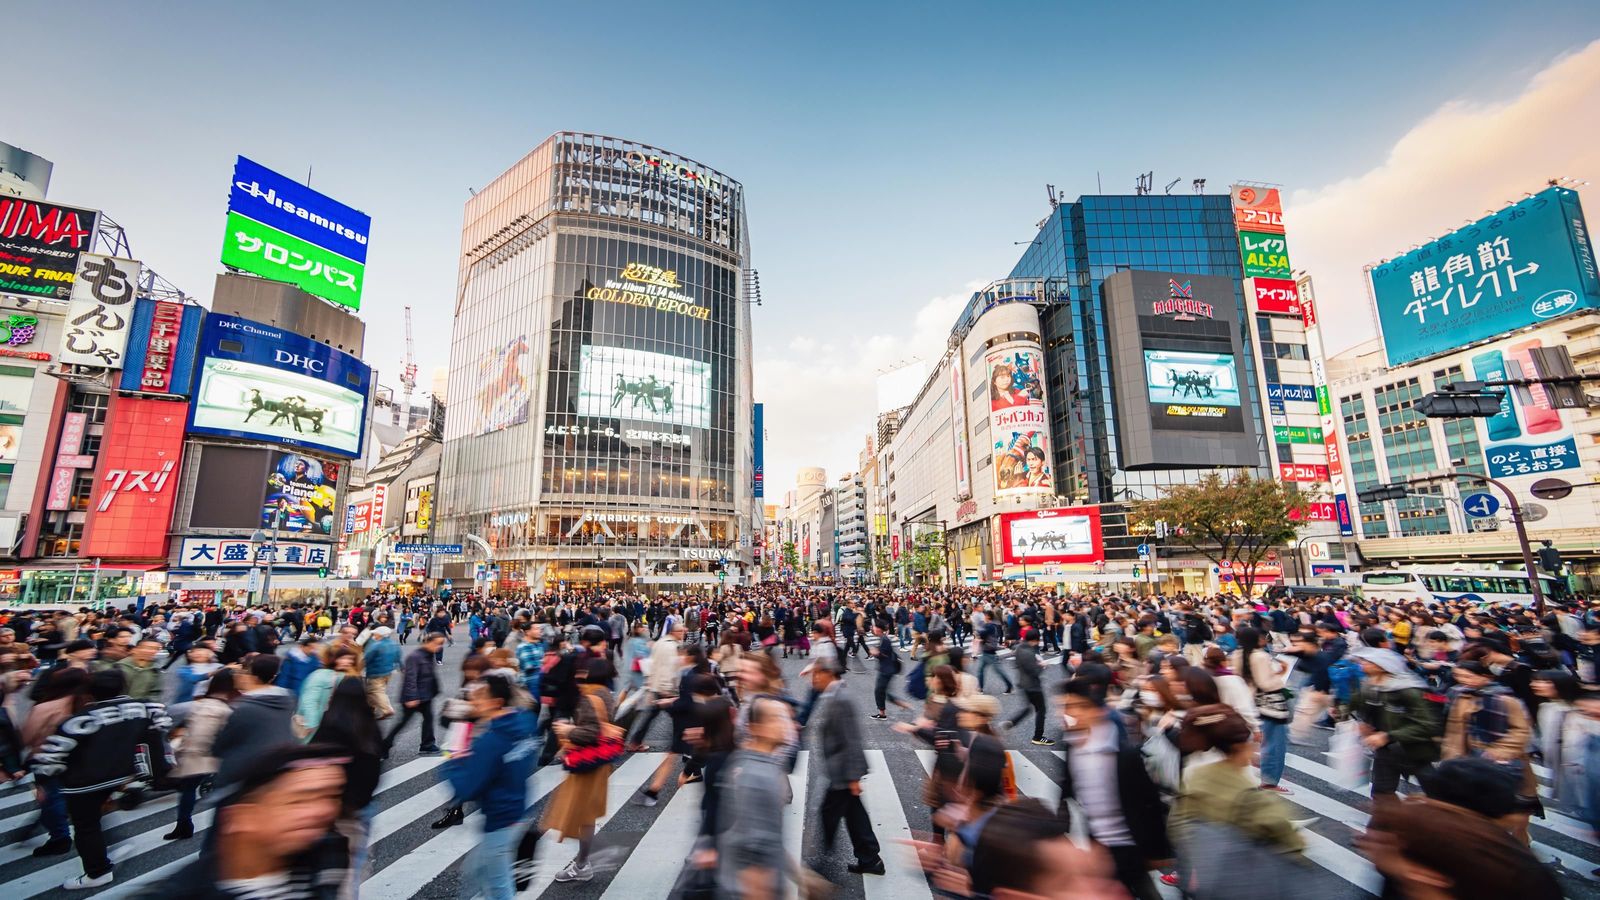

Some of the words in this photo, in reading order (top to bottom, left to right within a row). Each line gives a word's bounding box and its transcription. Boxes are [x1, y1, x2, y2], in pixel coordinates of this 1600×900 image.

[1242, 209, 1284, 225] アコム
[1244, 236, 1285, 253] レイク
[235, 231, 357, 293] サロンパス
[1246, 252, 1289, 268] ALSA
[1409, 235, 1513, 298] 龍角散
[646, 284, 668, 298] 11.14
[1256, 287, 1297, 301] アイフル
[1403, 262, 1540, 324] ダイレクト
[66, 257, 134, 365] もんじゃ
[587, 287, 658, 307] GOLDEN
[656, 297, 711, 320] EPOCH
[1153, 298, 1214, 319] MAGNET
[1535, 293, 1573, 314] 生薬
[219, 320, 242, 330] DHC
[243, 326, 282, 339] Channel
[141, 303, 178, 387] 三千里薬品
[274, 349, 324, 373] DHC
[1491, 444, 1575, 465] のど、直接、
[1284, 467, 1315, 478] アコム
[1501, 458, 1564, 475] うるおう
[97, 460, 176, 512] クスリ
[282, 484, 323, 498] Planets
[290, 480, 315, 490] teamLab
[585, 513, 651, 523] STARBUCKS
[656, 516, 694, 525] COFFEE
[190, 543, 326, 564] 大盛堂書店
[680, 547, 735, 560] TSUTAYA
